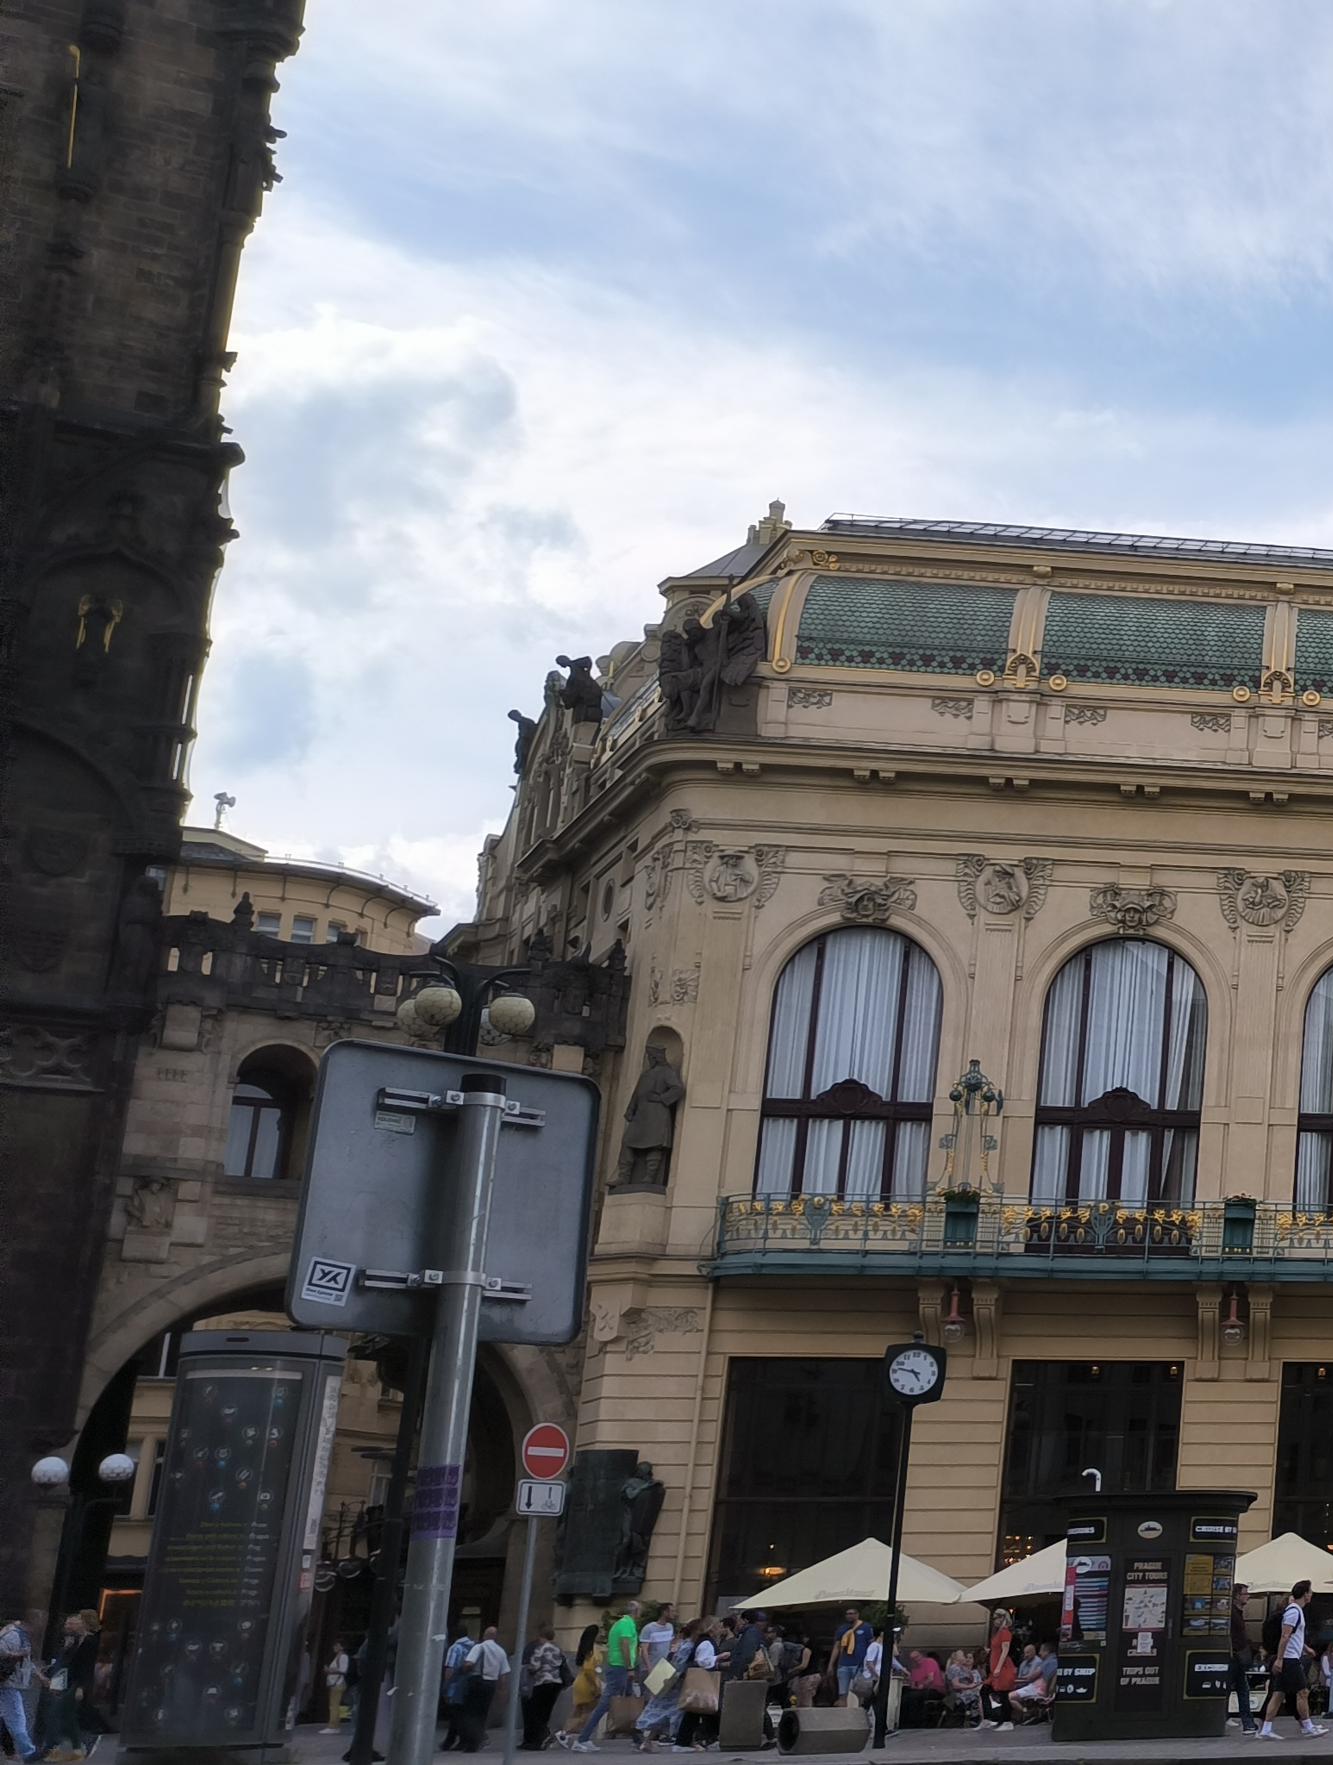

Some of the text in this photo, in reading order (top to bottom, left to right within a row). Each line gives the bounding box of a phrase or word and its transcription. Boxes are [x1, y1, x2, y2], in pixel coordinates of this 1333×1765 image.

[1126, 1571, 1168, 1580] CITY TOURS
[1122, 1666, 1159, 1675] TRIPS OUT
[1131, 1676, 1160, 1685] PRAGUE
